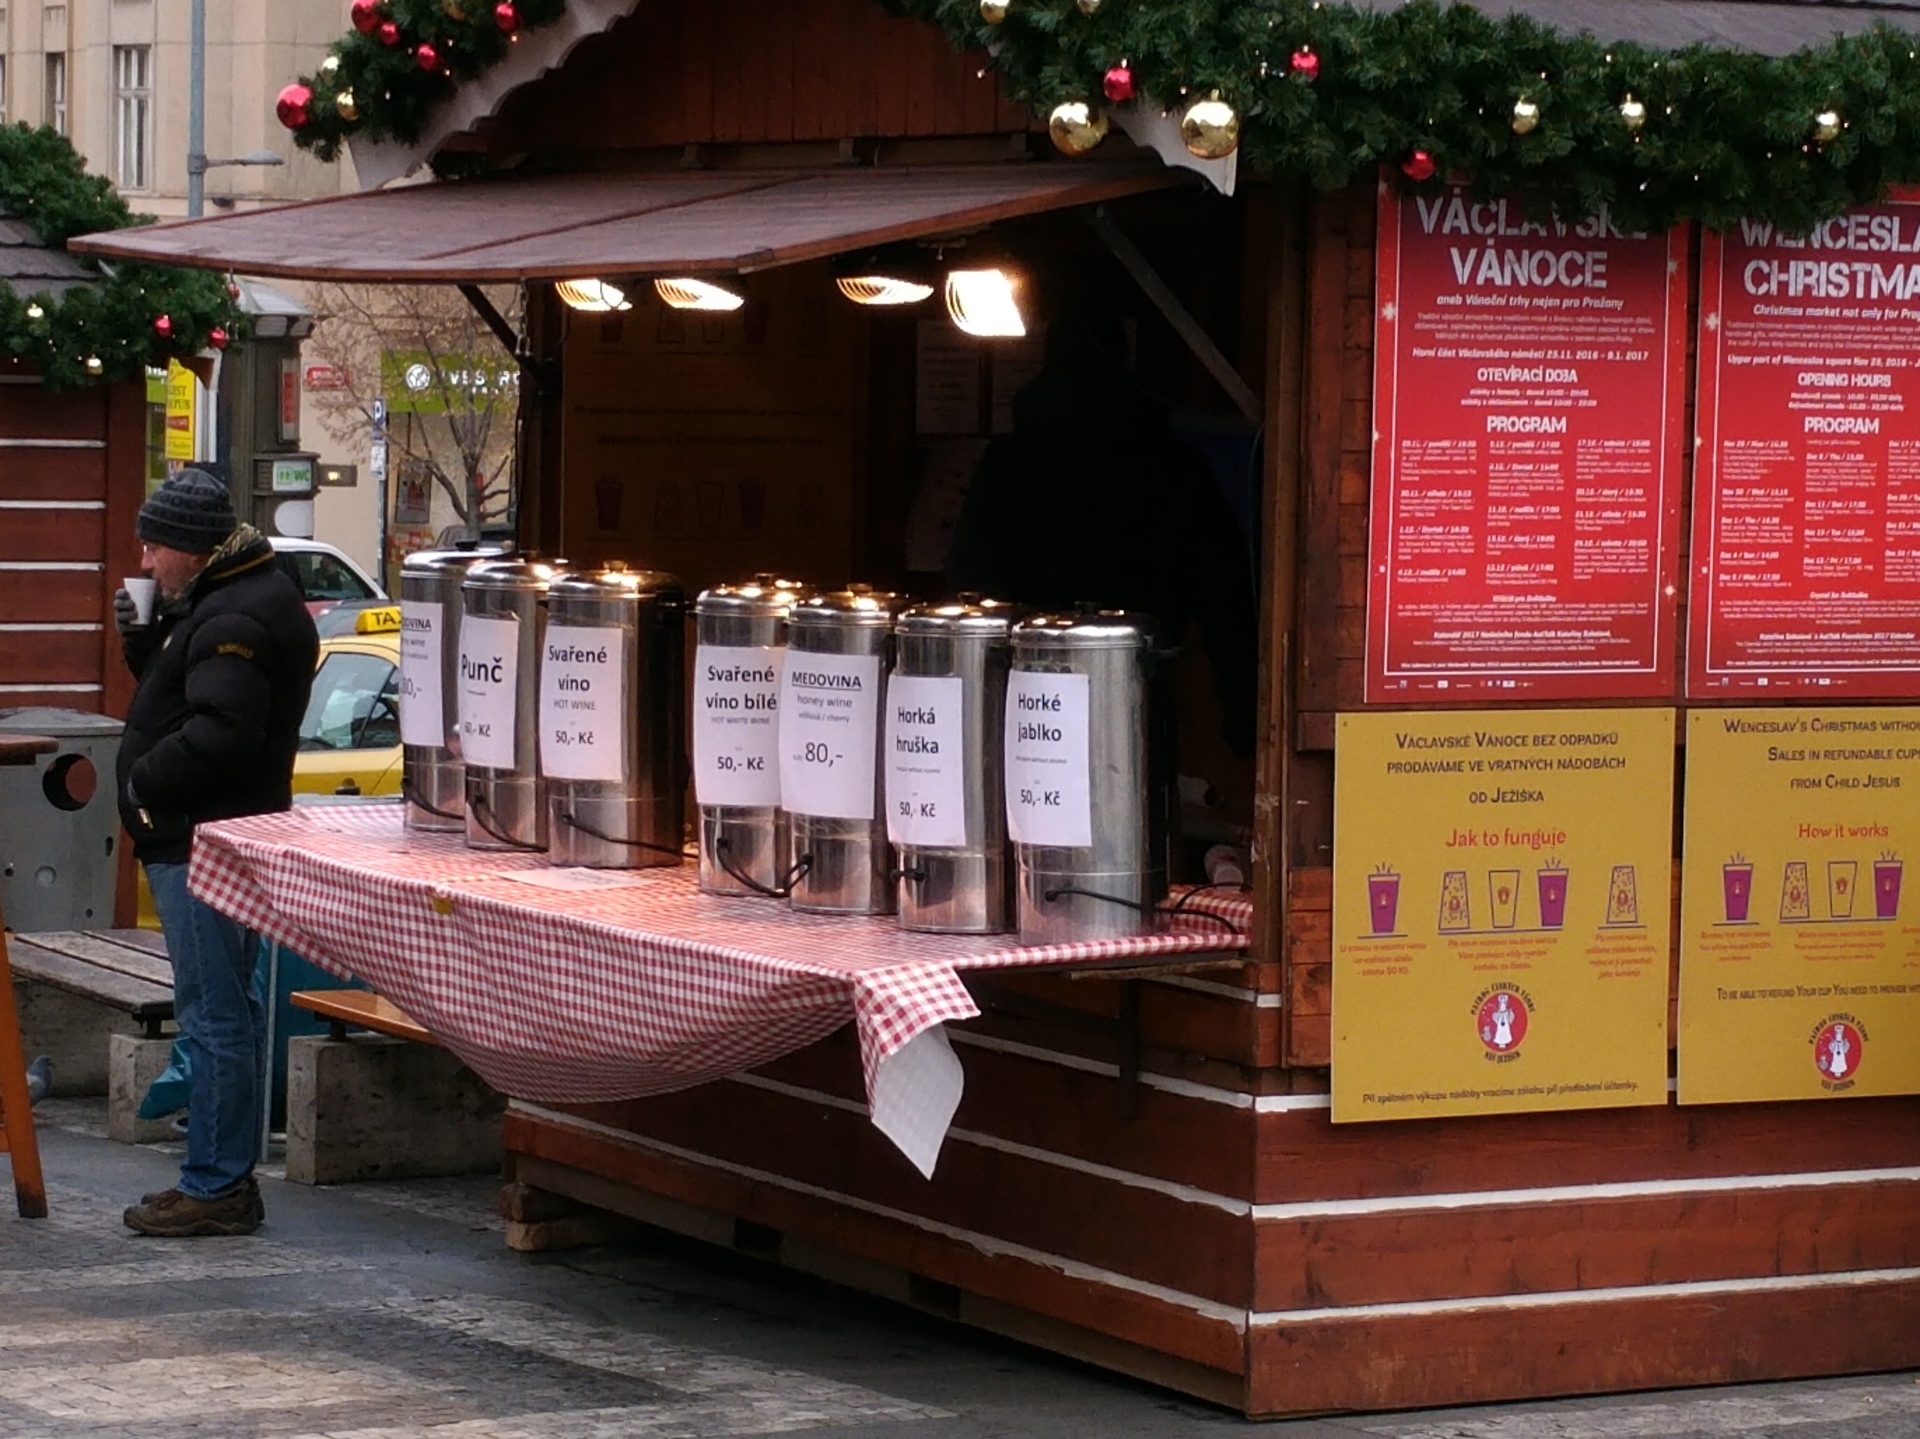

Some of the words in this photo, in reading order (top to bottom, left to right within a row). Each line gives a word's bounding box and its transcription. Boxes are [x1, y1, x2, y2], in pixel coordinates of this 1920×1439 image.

[1450, 238, 1608, 289] VÁNOCE
[1436, 295, 1463, 306] aneb
[1465, 294, 1507, 306] Vánoční
[1509, 295, 1530, 309] trhy
[1532, 296, 1561, 310] nejen
[1562, 298, 1580, 310] pro
[1582, 296, 1624, 311] Pražany
[1753, 304, 1803, 316] Christmas
[1805, 305, 1840, 317] market
[1842, 307, 1859, 318] not
[1861, 306, 1882, 321] only
[1884, 308, 1899, 320] for
[1575, 351, 1599, 360] 2016
[1625, 352, 1649, 361] 2017
[1727, 354, 1751, 365] Upper
[1752, 355, 1770, 365] part
[1477, 365, 1543, 383] OTEVÍRACÍ
[1798, 372, 1849, 387] OPENING
[1851, 373, 1892, 388] HOURS
[1486, 415, 1567, 434] PROGRAM
[1804, 416, 1880, 434] PROGRAM
[293, 468, 309, 482] WC
[548, 646, 608, 664] Svařené
[462, 653, 503, 684] Punč
[707, 665, 775, 683] Svařené
[558, 673, 590, 692] víno
[791, 671, 862, 689] MEDOVINA
[553, 699, 569, 710] HOT
[571, 700, 596, 711] WINE
[706, 691, 739, 710] víno
[743, 693, 778, 711] bílé
[797, 694, 824, 709] honey
[826, 696, 853, 708] wine
[1017, 692, 1062, 712] Horké
[897, 706, 936, 725] Horká
[478, 724, 491, 738] Kč
[1017, 722, 1062, 743] jablko
[1724, 716, 1807, 733] WENCESLAV'S
[1811, 718, 1877, 733] CHRISTMAS
[555, 730, 576, 747] 50,-
[578, 730, 594, 745] Kč
[896, 735, 939, 754] hruška
[1474, 731, 1529, 748] VÁNOCE
[1532, 734, 1556, 747] BEZ
[1559, 732, 1618, 746] ODPADKŮ
[804, 741, 844, 767] 80,-
[1768, 747, 1805, 761] SALES
[1808, 749, 1820, 761] IN
[1823, 748, 1892, 760] REFUNDABLE
[717, 756, 743, 772] 50,-
[747, 756, 765, 771] Kč
[1387, 759, 1465, 774] PRODÁVÁME
[1469, 760, 1484, 773] VE
[1487, 757, 1553, 772] VRATNÝCH
[1556, 755, 1626, 770] NÁDOBÁCH
[1790, 777, 1821, 789] FROM
[1825, 774, 1860, 788] CHILD
[1862, 774, 1900, 788] JESUS
[1020, 789, 1041, 806] 50,-
[1044, 790, 1061, 806] Kč
[1468, 791, 1488, 804] OD
[1491, 787, 1544, 804] JEŽÍŠKA
[899, 801, 916, 818] 50,-
[920, 802, 936, 818] Kč
[1445, 828, 1478, 848] Jak
[1482, 829, 1500, 848] to
[1503, 828, 1567, 850] funguje
[1798, 824, 1832, 838] How
[1835, 824, 1844, 838] it
[1848, 823, 1889, 838] works
